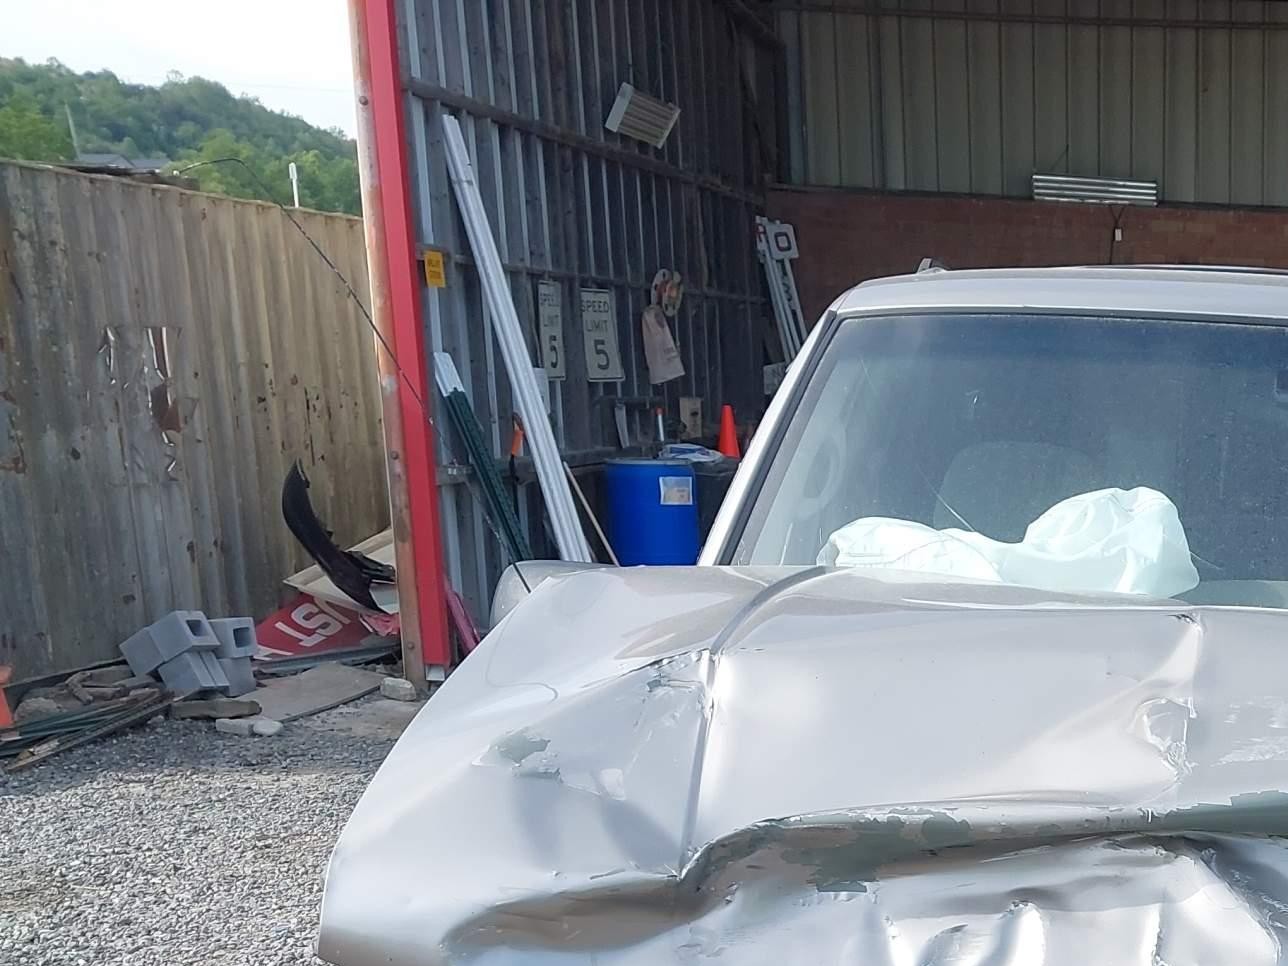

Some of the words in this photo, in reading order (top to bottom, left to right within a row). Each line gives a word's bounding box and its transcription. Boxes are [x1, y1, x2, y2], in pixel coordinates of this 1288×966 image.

[579, 300, 610, 313] SPEED
[585, 319, 609, 333] LIMIT
[548, 335, 559, 369] 5
[593, 339, 610, 370] 5
